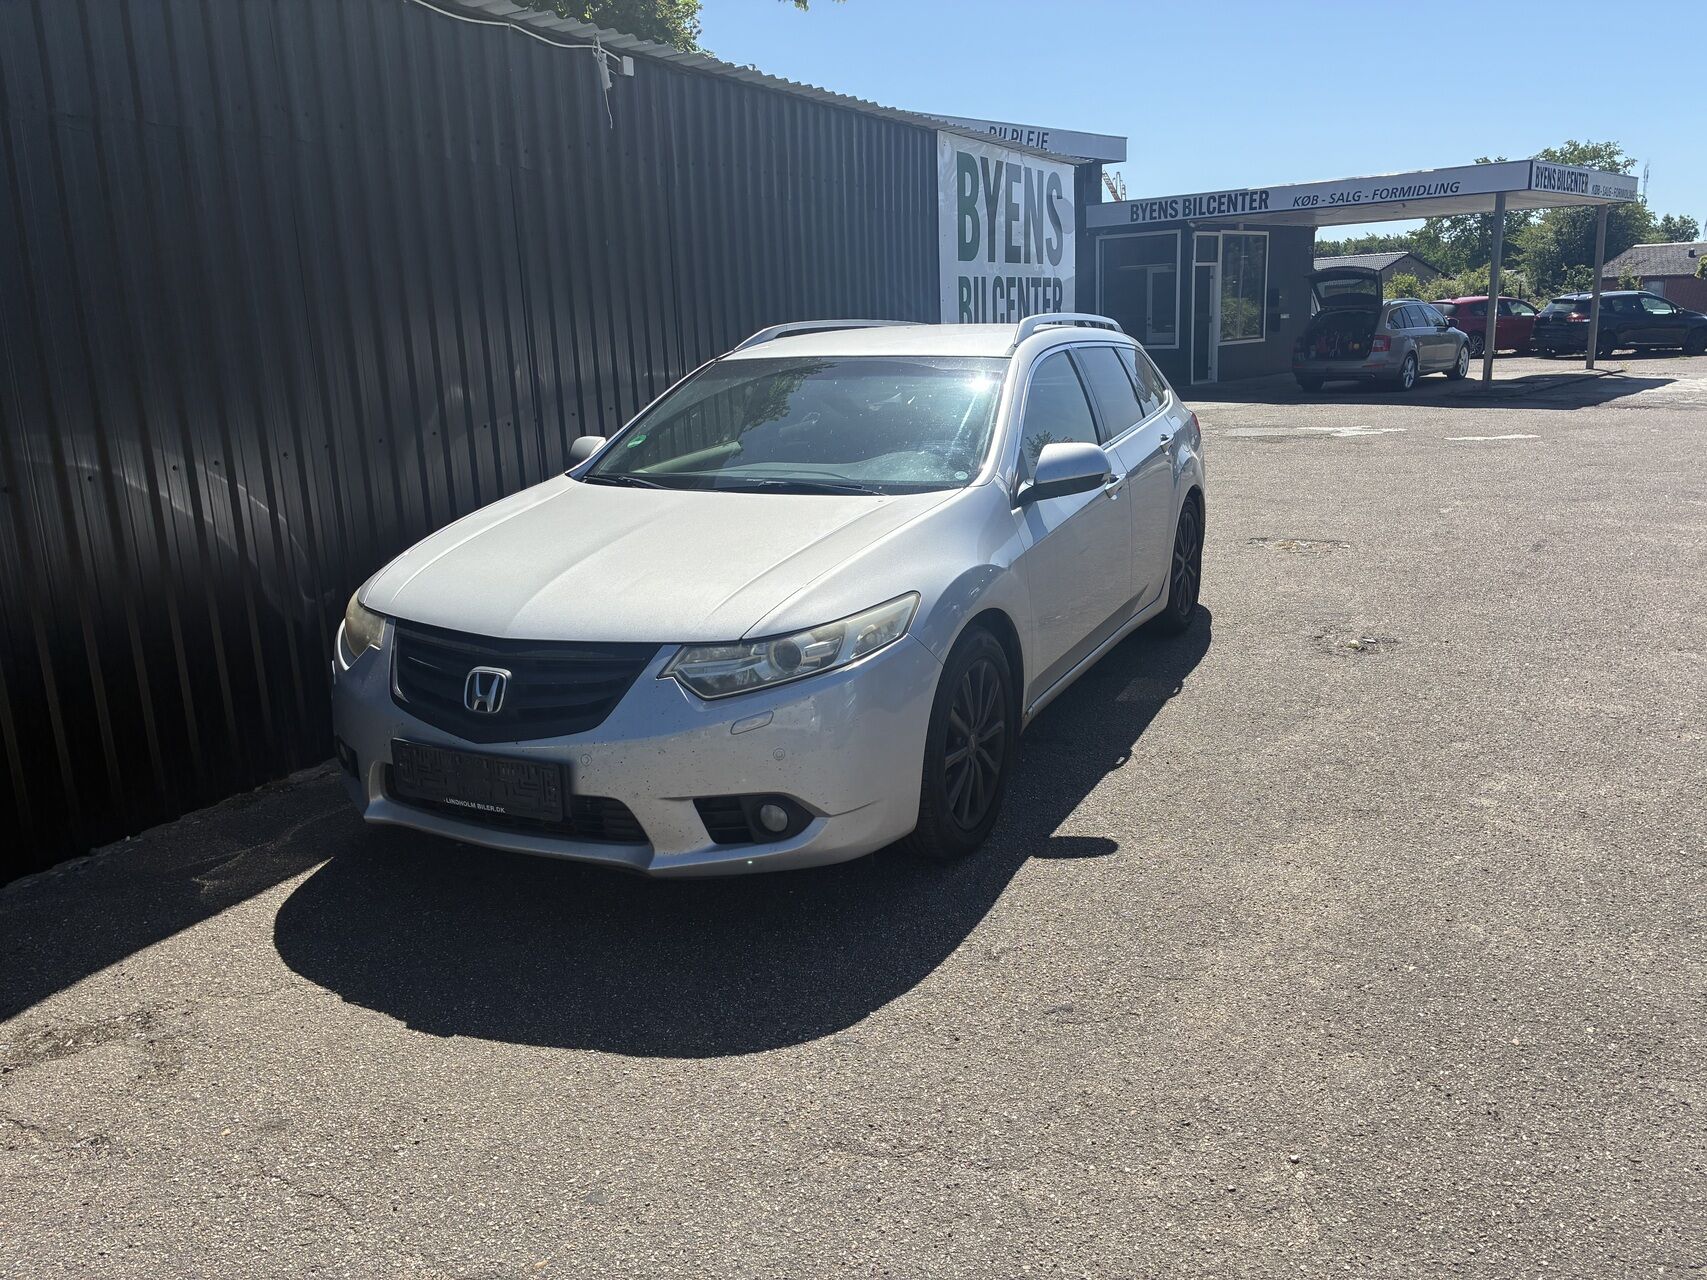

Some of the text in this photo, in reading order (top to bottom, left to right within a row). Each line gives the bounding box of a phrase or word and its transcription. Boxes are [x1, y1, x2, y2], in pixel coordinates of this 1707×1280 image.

[1292, 194, 1319, 208] KØB
[1328, 190, 1361, 205] SALG
[1371, 181, 1461, 201] FORMIDLING
[1535, 165, 1589, 194] BYENS BILCENTER
[956, 150, 1064, 267] BYENS
[1130, 190, 1270, 223] BYENS BILCENTER
[958, 275, 1063, 325] BILCENTER
